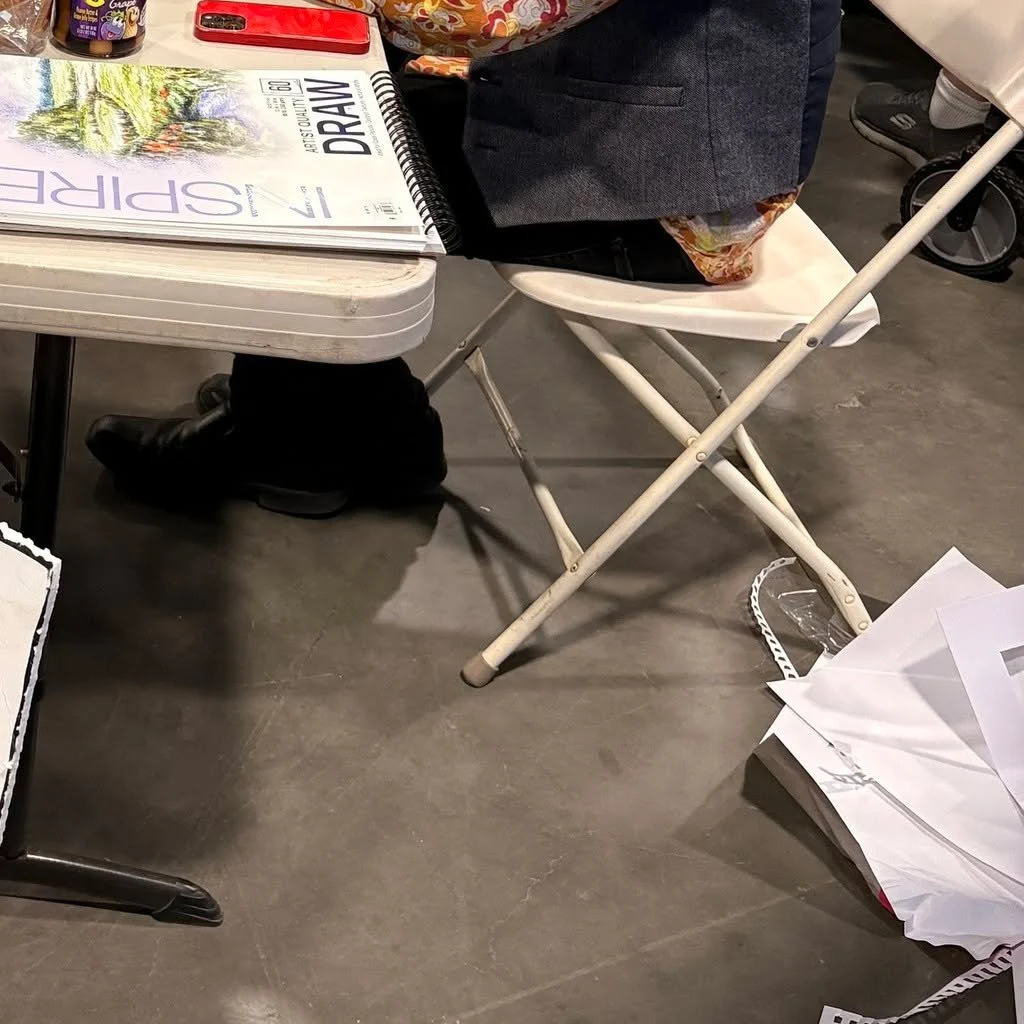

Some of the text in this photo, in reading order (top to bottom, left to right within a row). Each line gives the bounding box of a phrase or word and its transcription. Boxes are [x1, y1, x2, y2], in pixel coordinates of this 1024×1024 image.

[268, 80, 292, 92] 60
[292, 97, 318, 154] ARTIST QUALITY
[304, 77, 373, 156] DRAW
